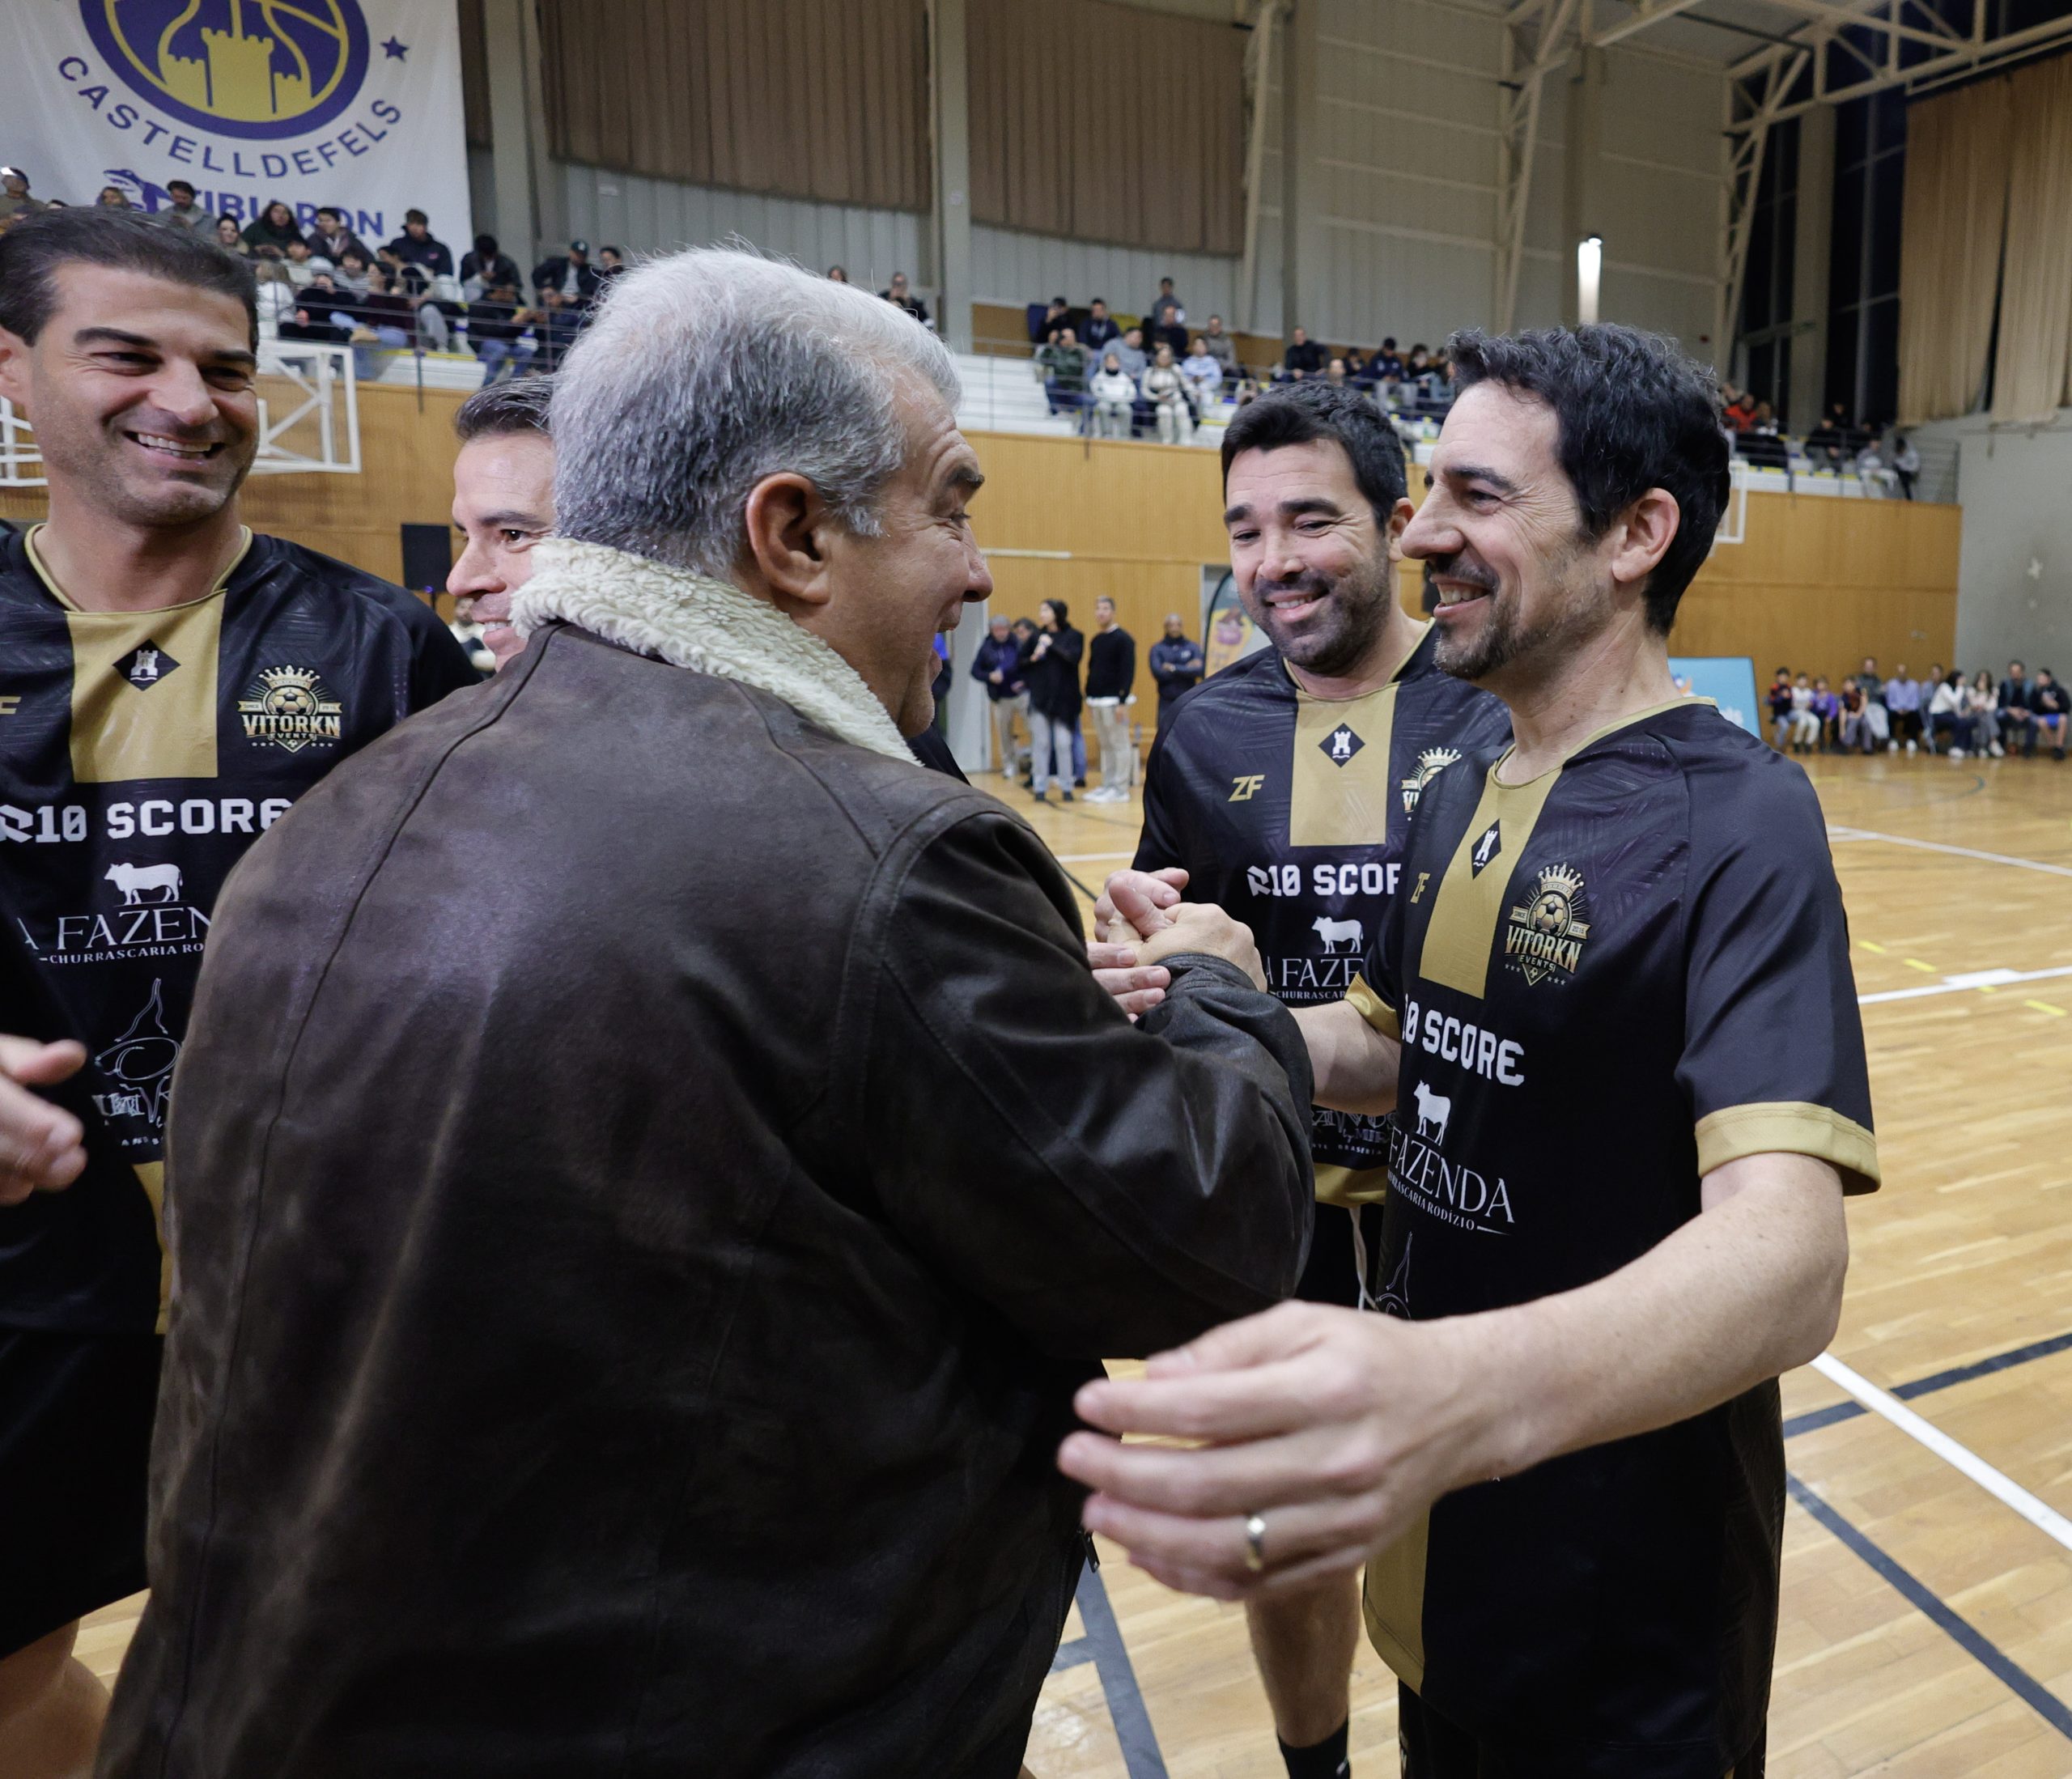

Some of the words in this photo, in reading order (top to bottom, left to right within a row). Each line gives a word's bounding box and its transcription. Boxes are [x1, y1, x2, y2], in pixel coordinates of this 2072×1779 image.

[58, 56, 401, 179] CASTELLDEFELS
[241, 715, 341, 738] VITORKN
[268, 732, 316, 741] EVENTS
[1228, 775, 1265, 802] ZF
[1246, 865, 1301, 897] R10
[49, 945, 177, 964] CHURRASCARIA
[1505, 924, 1583, 974] VITORKN
[1518, 954, 1556, 971] EVENTS
[1422, 1009, 1525, 1086] SCORE
[1389, 1126, 1515, 1223] FAZENDA
[1427, 1201, 1475, 1230] RODÍZIO
